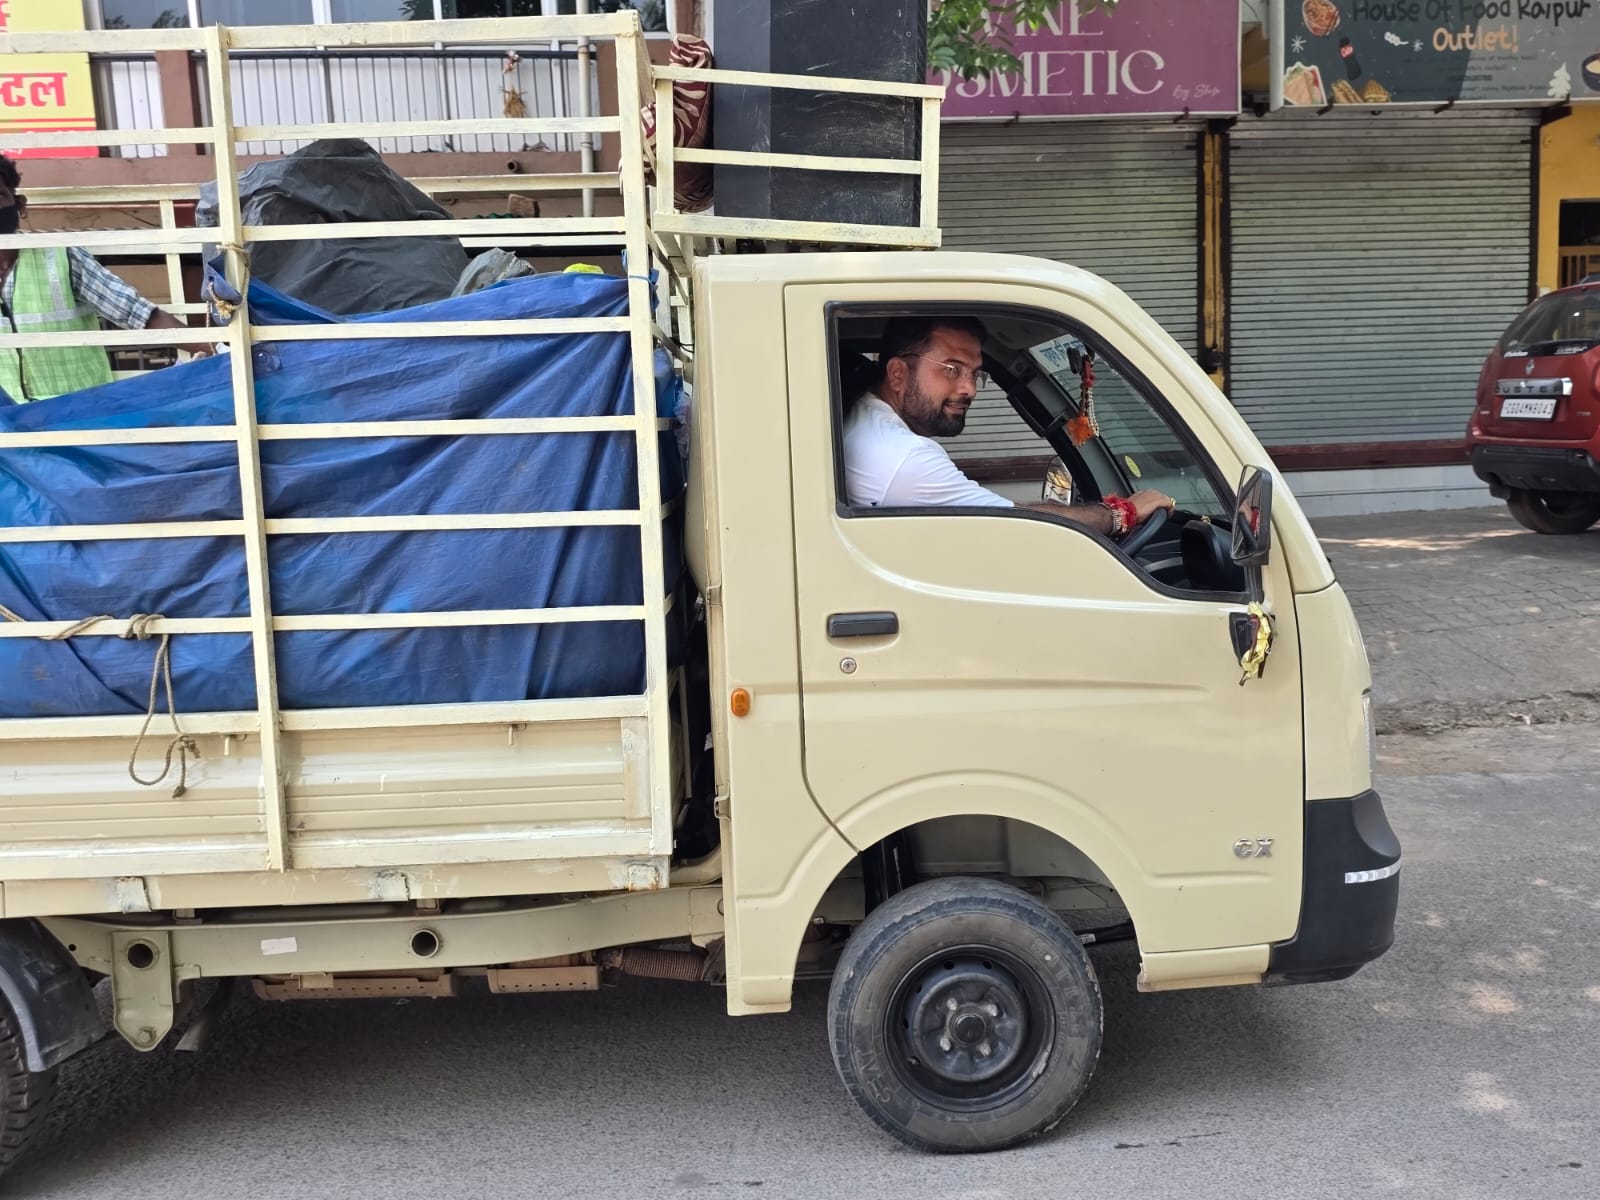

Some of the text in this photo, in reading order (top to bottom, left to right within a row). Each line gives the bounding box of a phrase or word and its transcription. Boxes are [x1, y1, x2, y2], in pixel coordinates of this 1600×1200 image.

[1352, 0, 1419, 21] House
[1459, 0, 1510, 20] Food
[1433, 25, 1518, 52] Outlet!
[941, 50, 1165, 97] SMETIC
